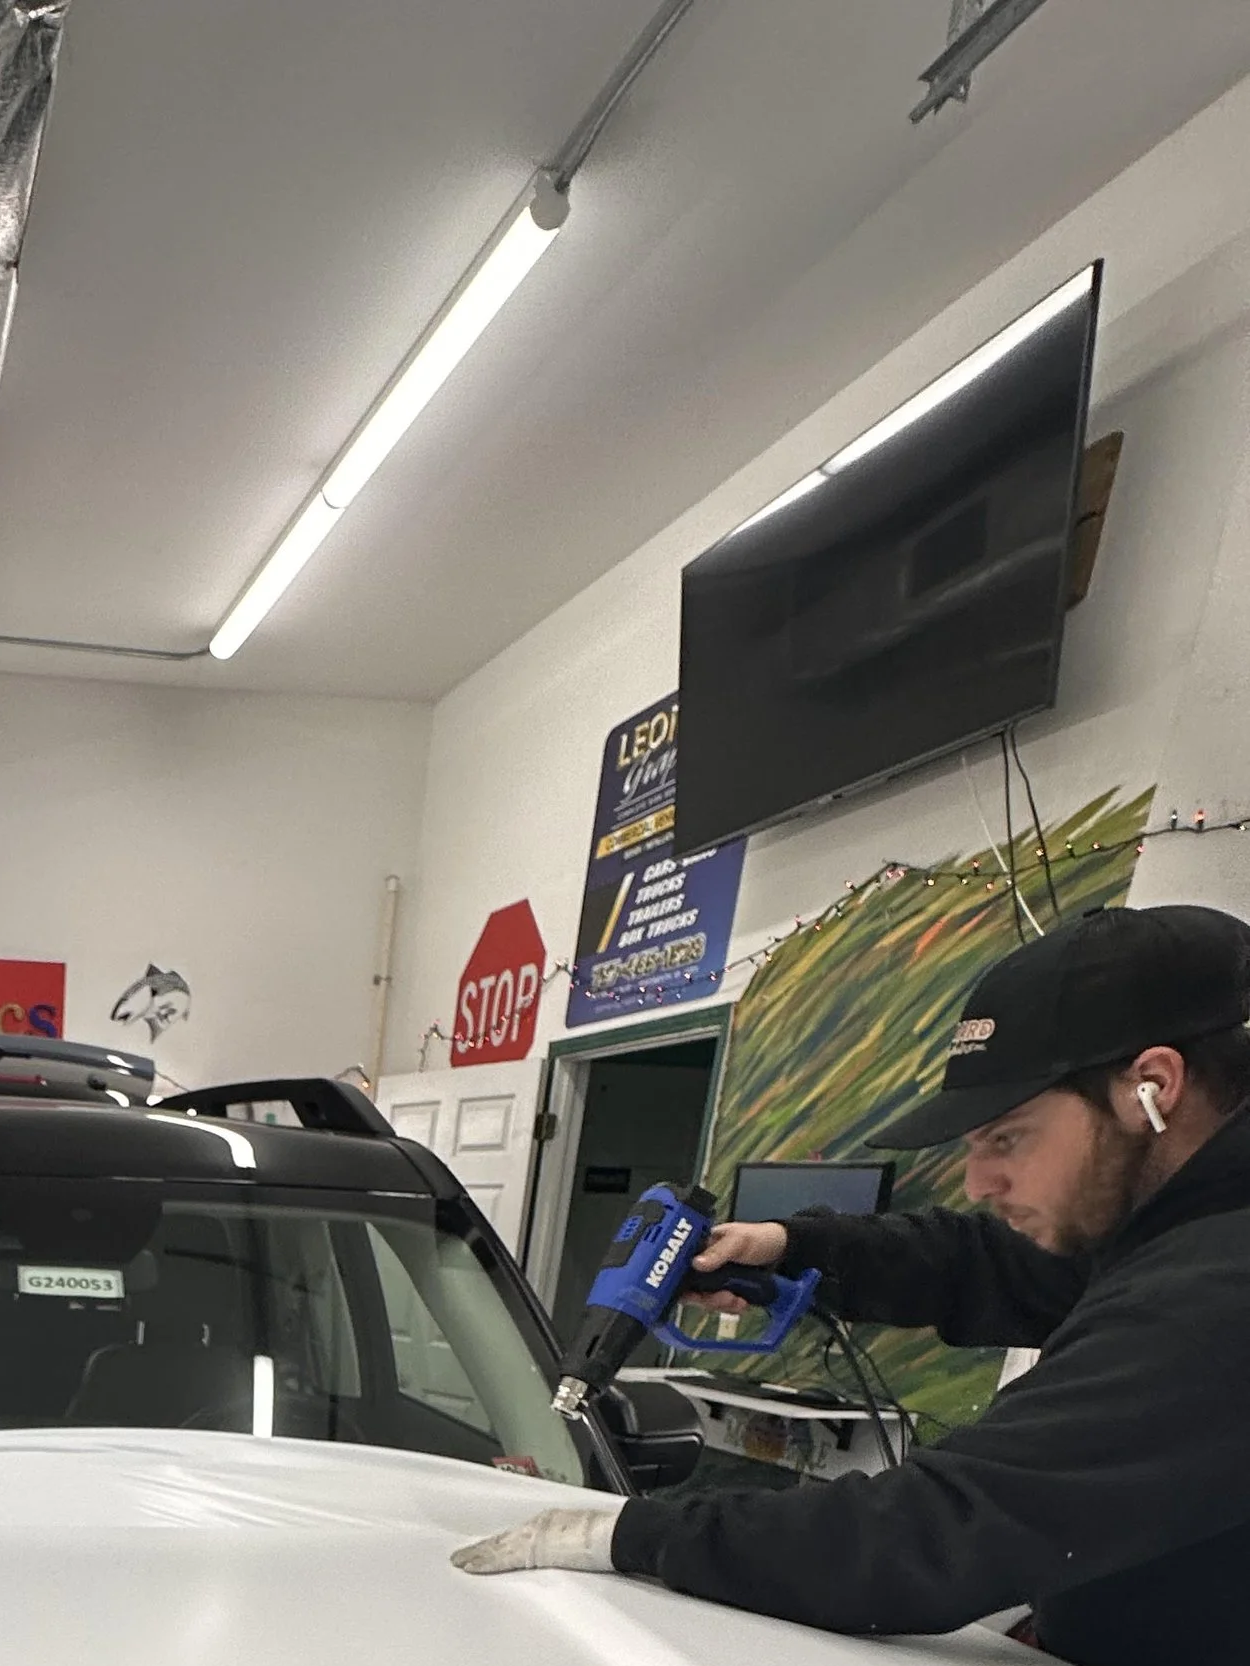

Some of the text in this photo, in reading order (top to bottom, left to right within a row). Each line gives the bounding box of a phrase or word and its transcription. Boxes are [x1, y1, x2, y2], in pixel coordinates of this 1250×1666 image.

[635, 872, 686, 904] TRUCKS
[647, 908, 699, 939] TRUCKS
[456, 963, 538, 1053] STOP
[646, 1218, 693, 1288] KOBALT
